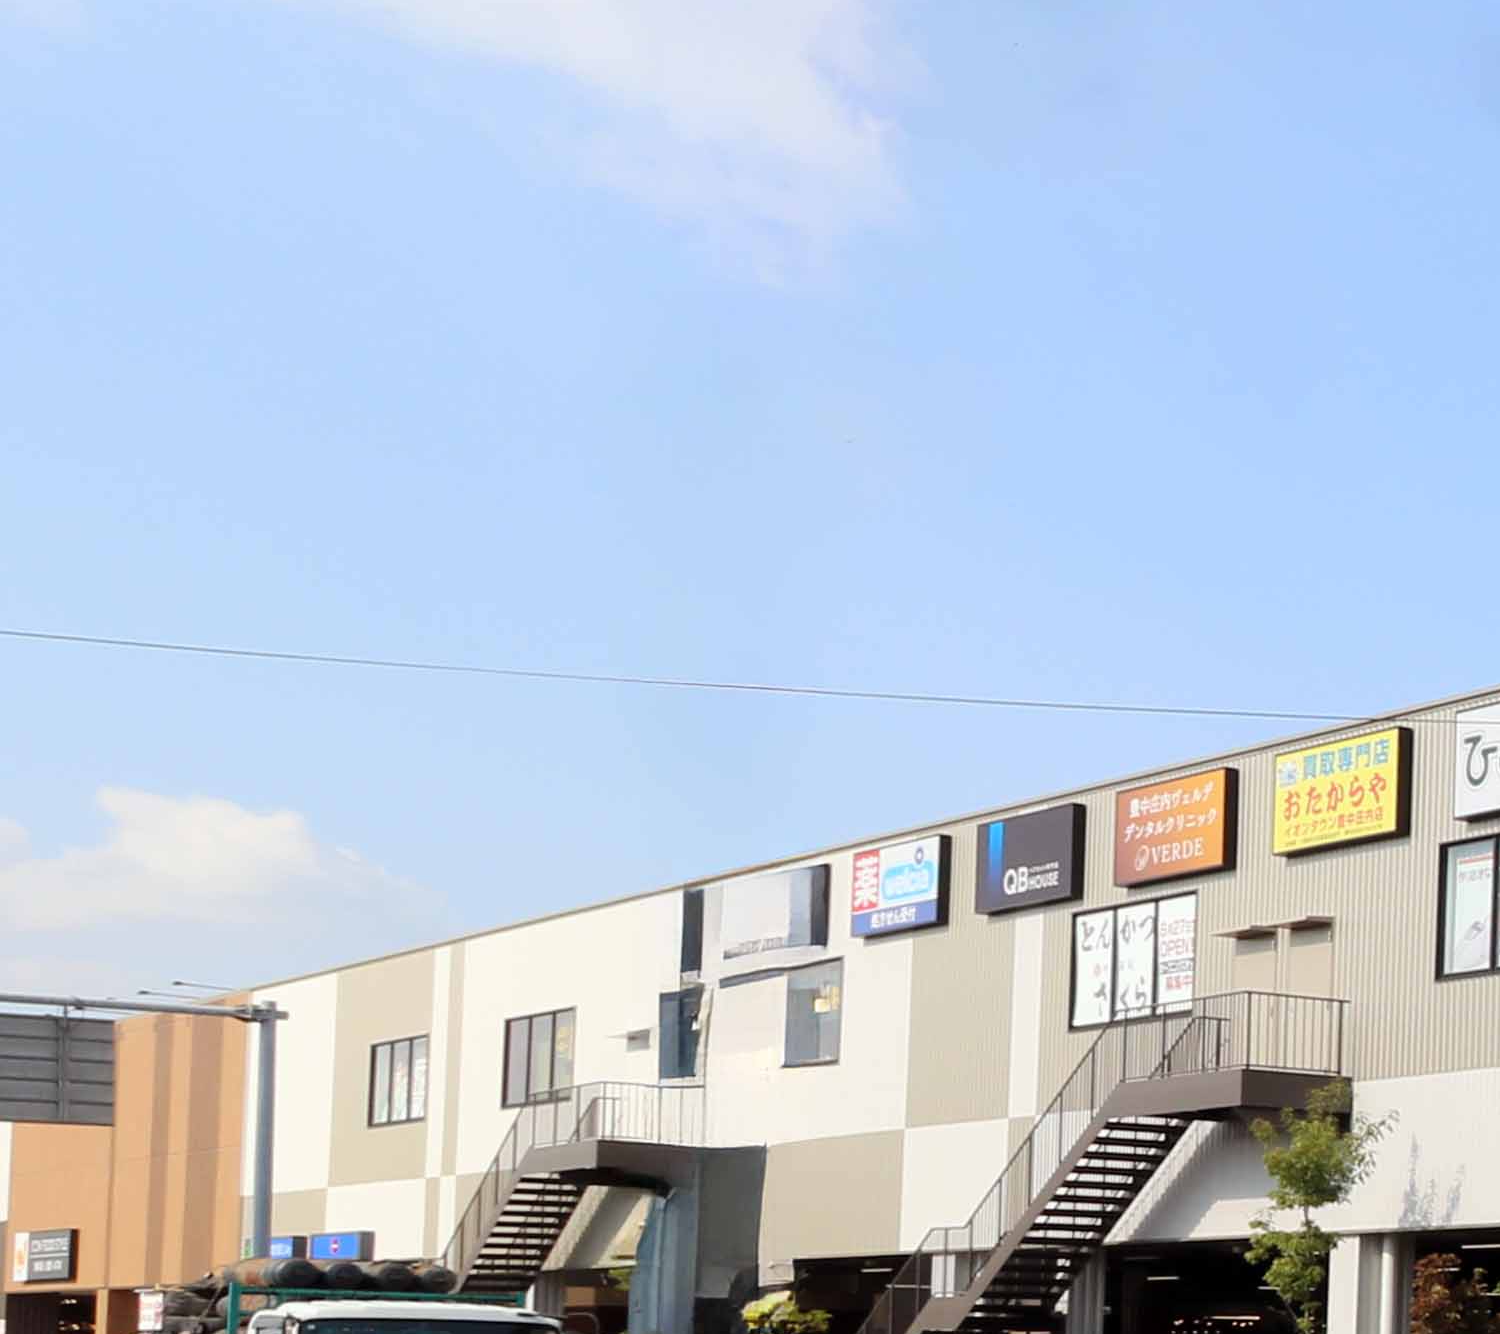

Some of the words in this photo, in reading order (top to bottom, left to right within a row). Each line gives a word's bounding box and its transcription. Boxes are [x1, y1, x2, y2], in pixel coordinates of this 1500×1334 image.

[1283, 772, 1387, 822] おたからや
[1151, 836, 1205, 866] VERDE
[1003, 866, 1028, 896] QB
[1028, 871, 1060, 890] HOUSE
